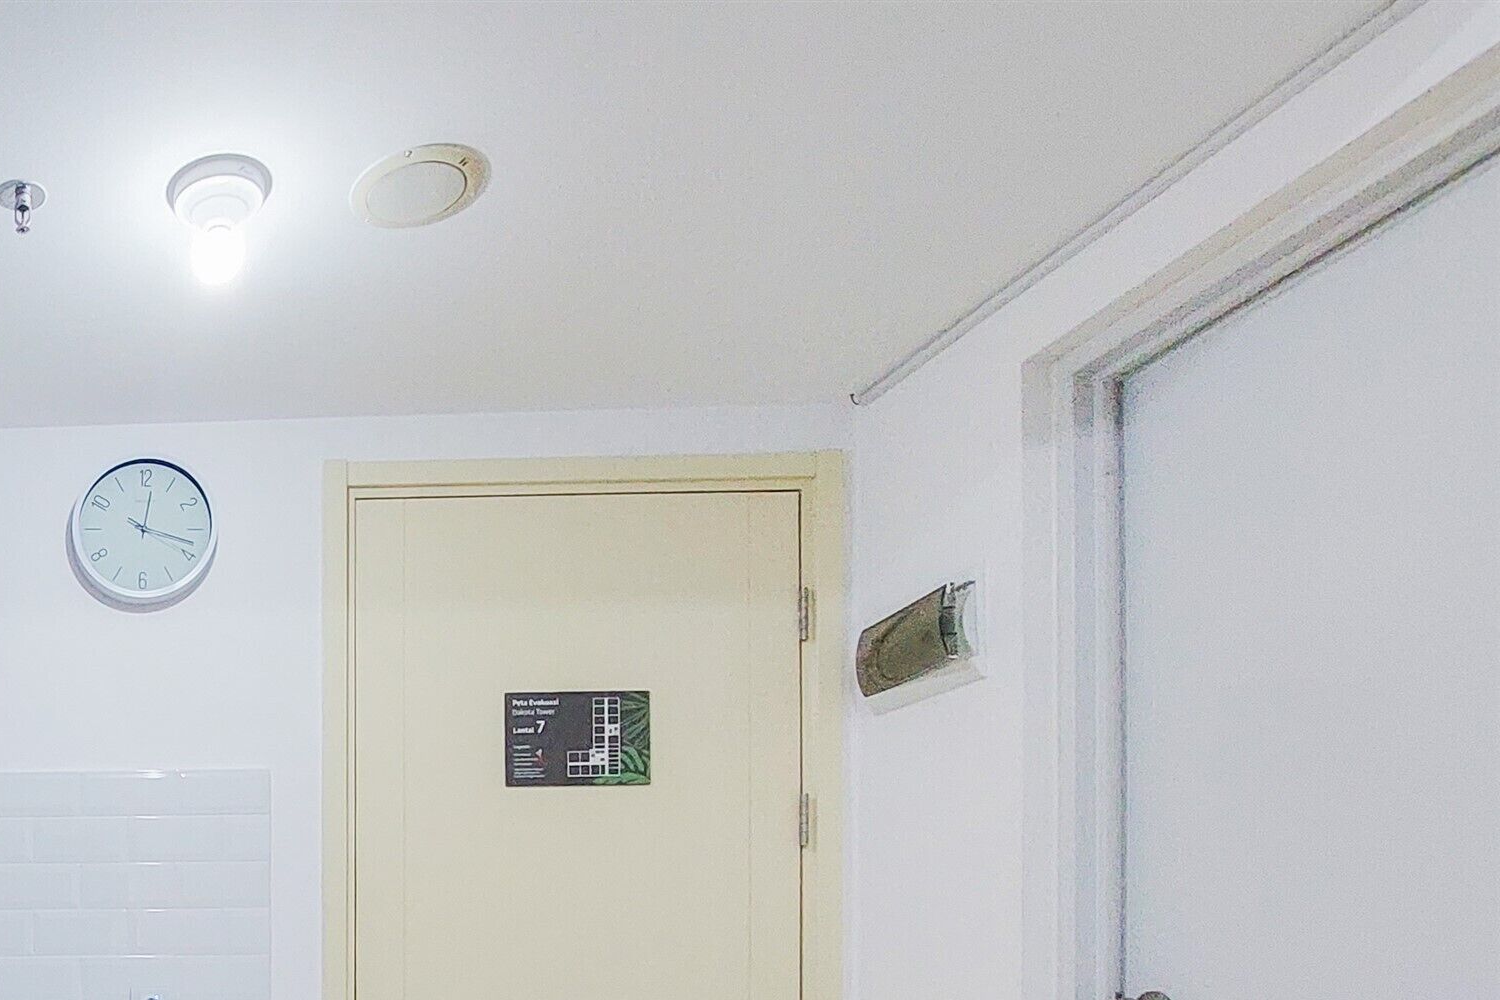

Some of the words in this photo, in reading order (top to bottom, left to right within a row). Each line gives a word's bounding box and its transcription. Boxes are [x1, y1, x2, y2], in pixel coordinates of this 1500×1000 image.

[139, 469, 153, 488] 12
[91, 494, 111, 511] 10
[179, 496, 198, 511] 2
[90, 548, 108, 562] 8
[180, 548, 197, 561] 4
[138, 571, 148, 590] 6
[536, 720, 545, 733] 7
